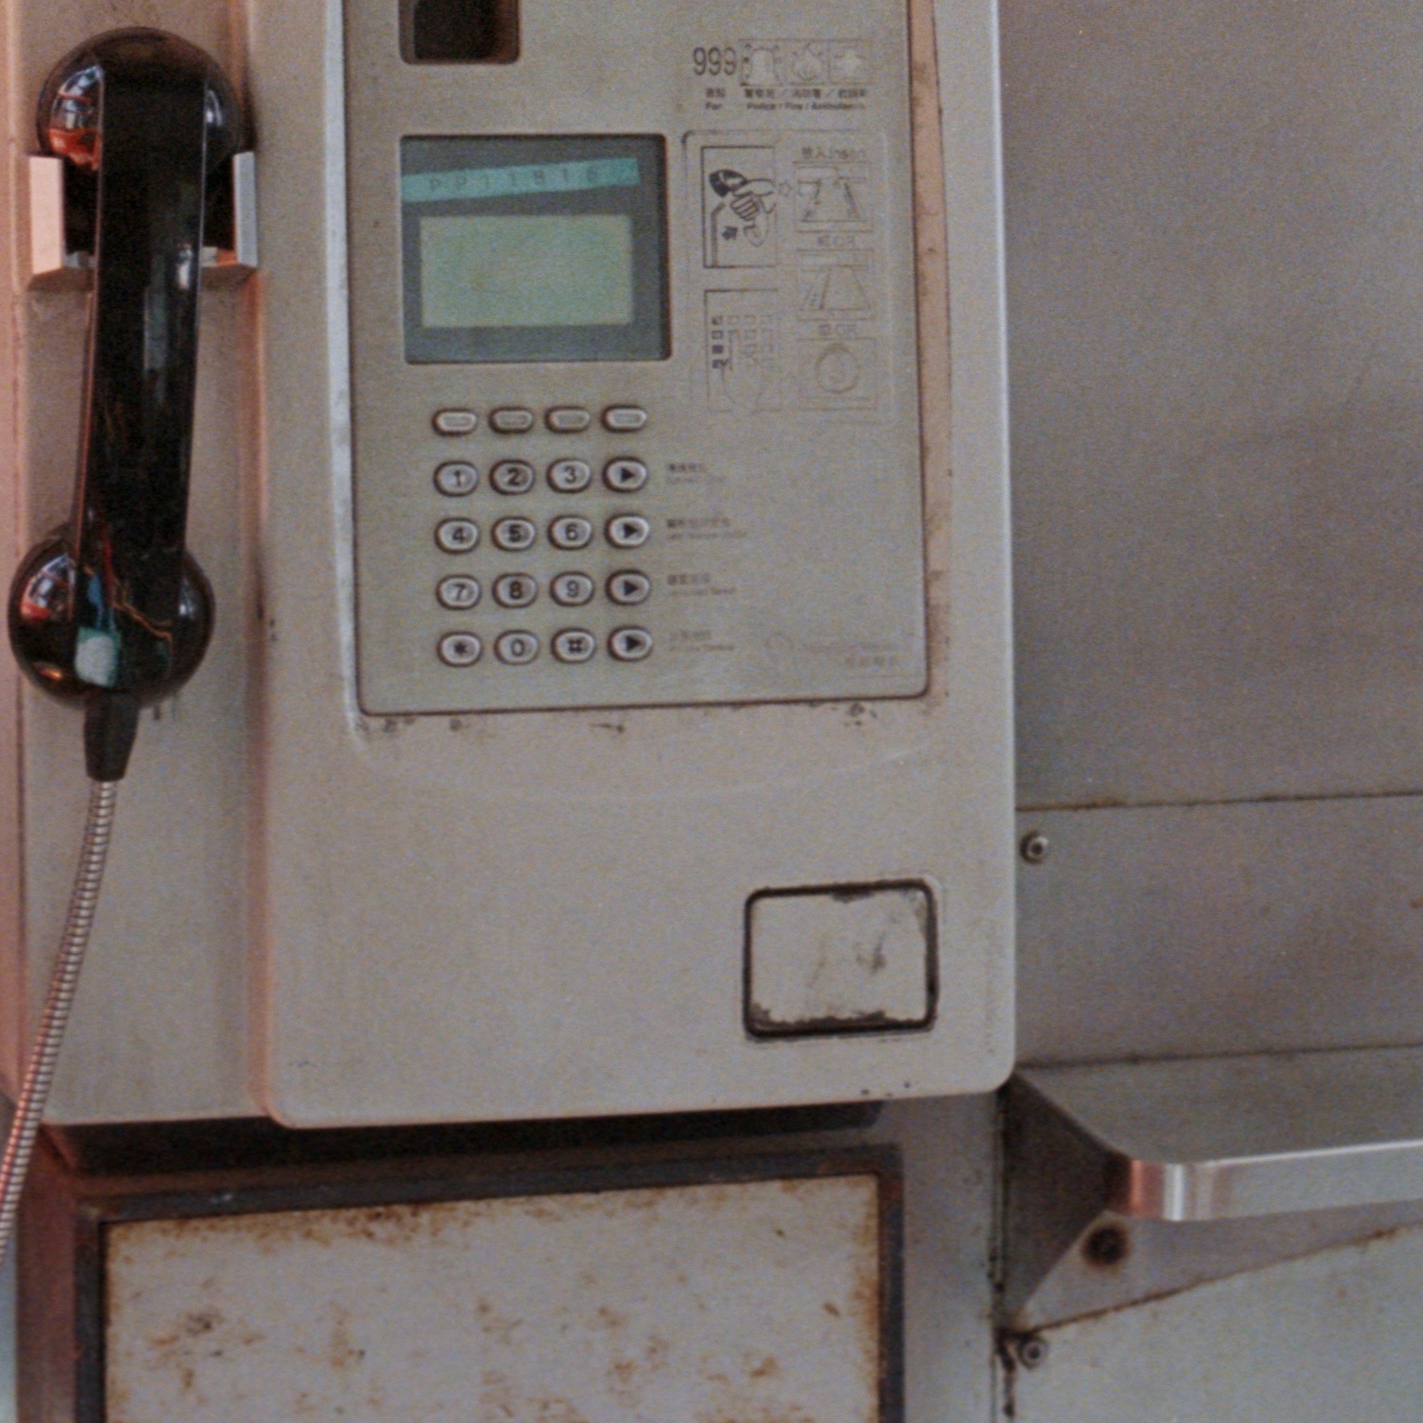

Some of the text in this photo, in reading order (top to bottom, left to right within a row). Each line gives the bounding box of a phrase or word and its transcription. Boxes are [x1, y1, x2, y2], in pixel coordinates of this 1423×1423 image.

[693, 47, 737, 76] 999
[507, 467, 521, 486] 2
[564, 465, 578, 484] 3
[452, 522, 579, 544] 4 5 6
[453, 579, 580, 602] 7 8 9
[510, 638, 526, 657] 0
